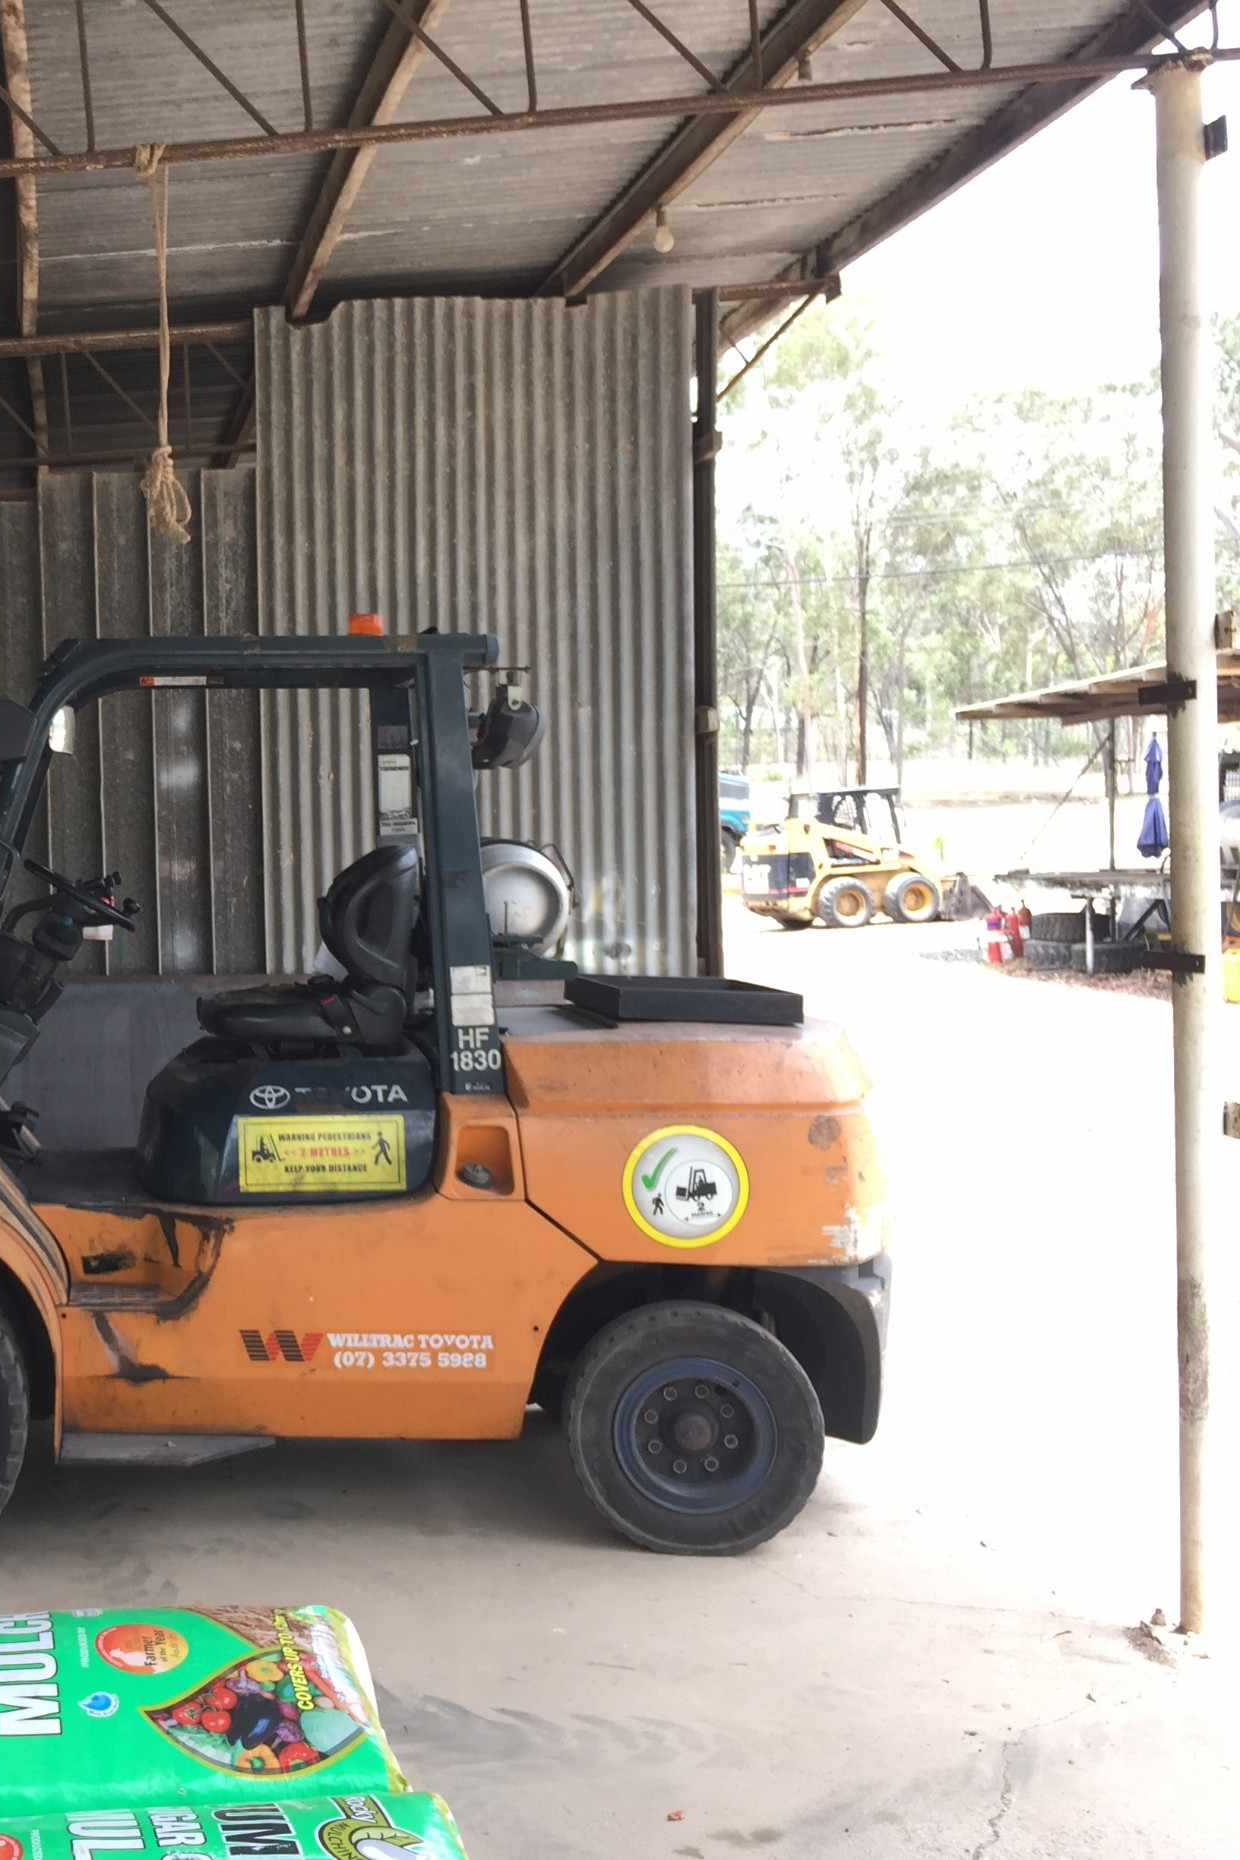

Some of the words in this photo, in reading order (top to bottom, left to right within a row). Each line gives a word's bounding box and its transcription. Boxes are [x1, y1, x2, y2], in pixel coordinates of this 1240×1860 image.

[457, 1027, 490, 1049] HF
[450, 1049, 502, 1072] 1830
[278, 1133, 315, 1142] WARNING
[318, 1131, 371, 1141] PEDESTRIANS
[300, 1147, 306, 1157] 2
[310, 1147, 350, 1157] METRES
[284, 1165, 304, 1173] KEEP
[305, 1164, 327, 1173] YOUR
[328, 1164, 367, 1173] DISTANCE
[326, 1333, 414, 1348] WILLTRAC
[418, 1333, 494, 1349] TOYOTA
[333, 1351, 375, 1368] (07)
[382, 1351, 431, 1368] 3375
[153, 1630, 167, 1646] Year
[277, 1632, 294, 1645] TO
[78, 1634, 89, 1668] PRODUCED
[142, 1636, 157, 1666] Farmer
[282, 1646, 300, 1661] UP
[287, 1662, 315, 1711] COVERS
